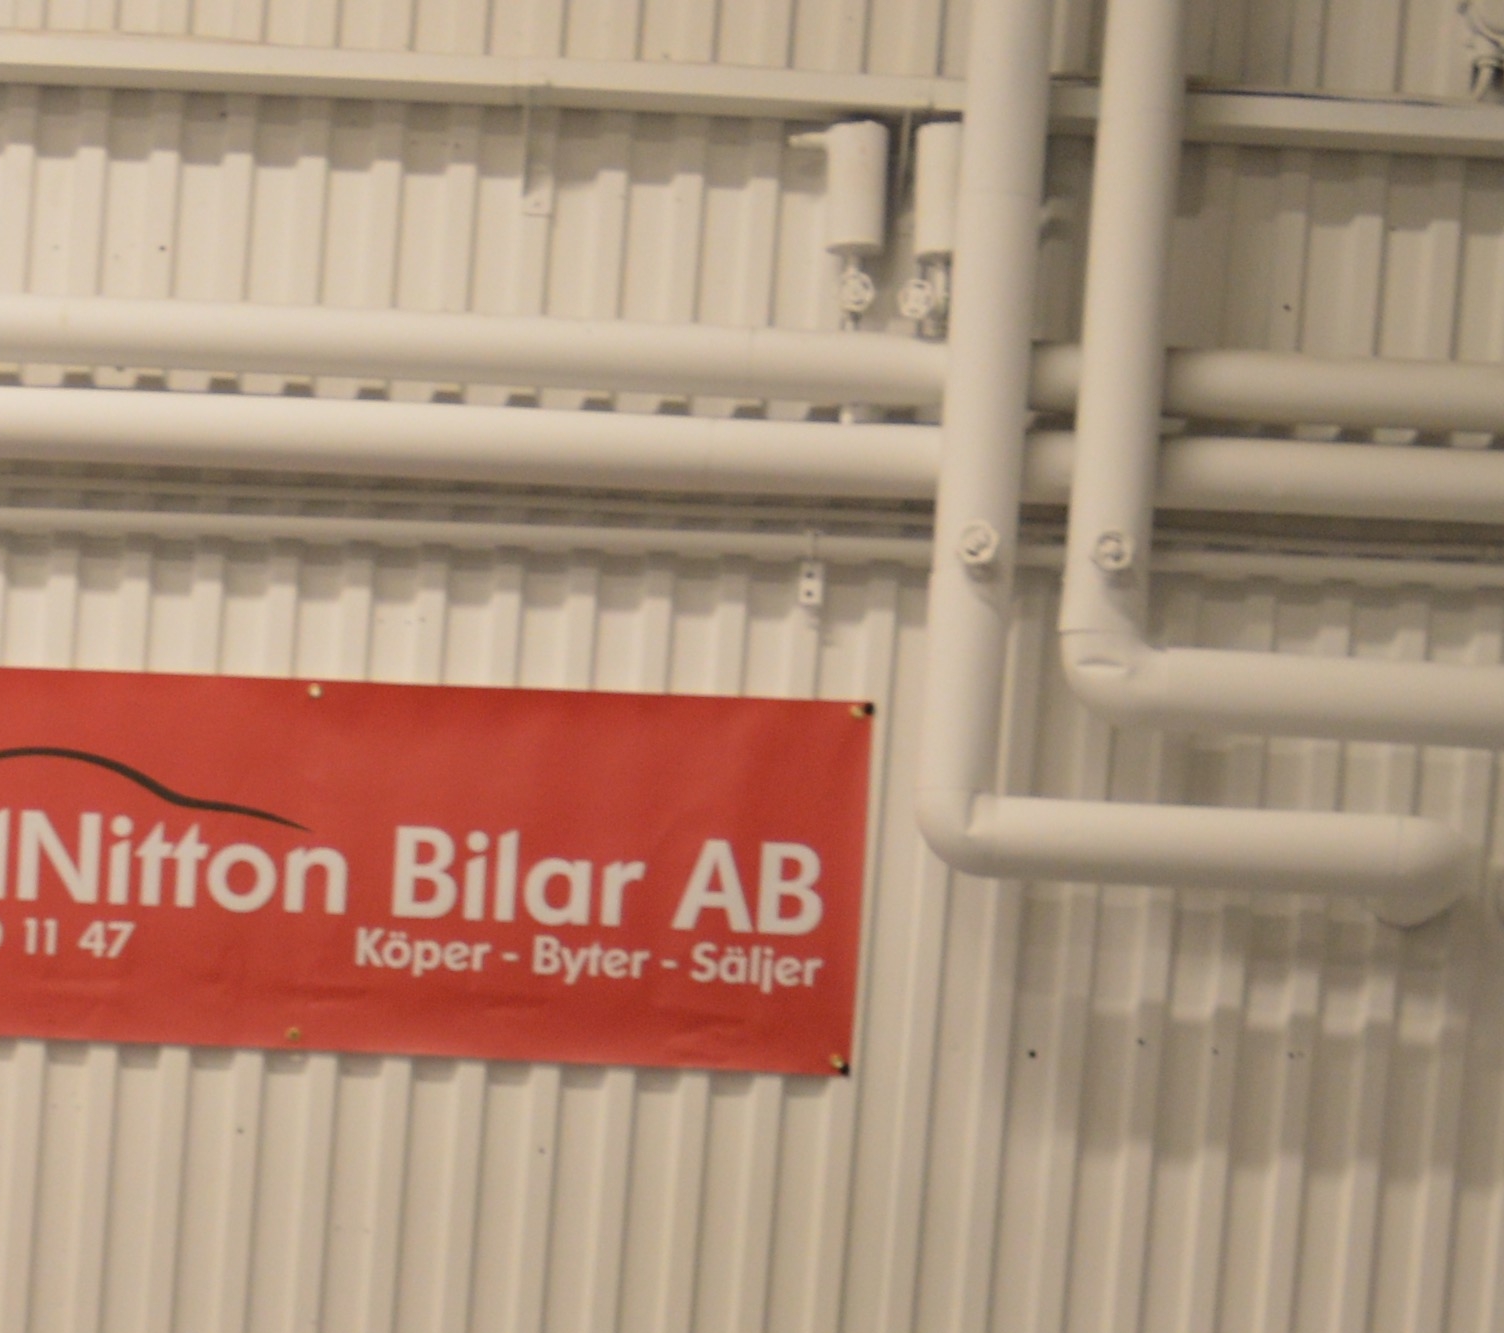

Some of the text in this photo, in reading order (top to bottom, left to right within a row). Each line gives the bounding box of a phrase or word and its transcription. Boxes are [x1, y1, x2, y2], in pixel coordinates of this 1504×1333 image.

[393, 825, 646, 927] Bilar
[671, 838, 824, 936] AB
[24, 917, 58, 955] 11
[78, 920, 135, 958] 47
[355, 927, 491, 977] Köper
[532, 935, 650, 985] Byter
[690, 942, 824, 994] Säljer
